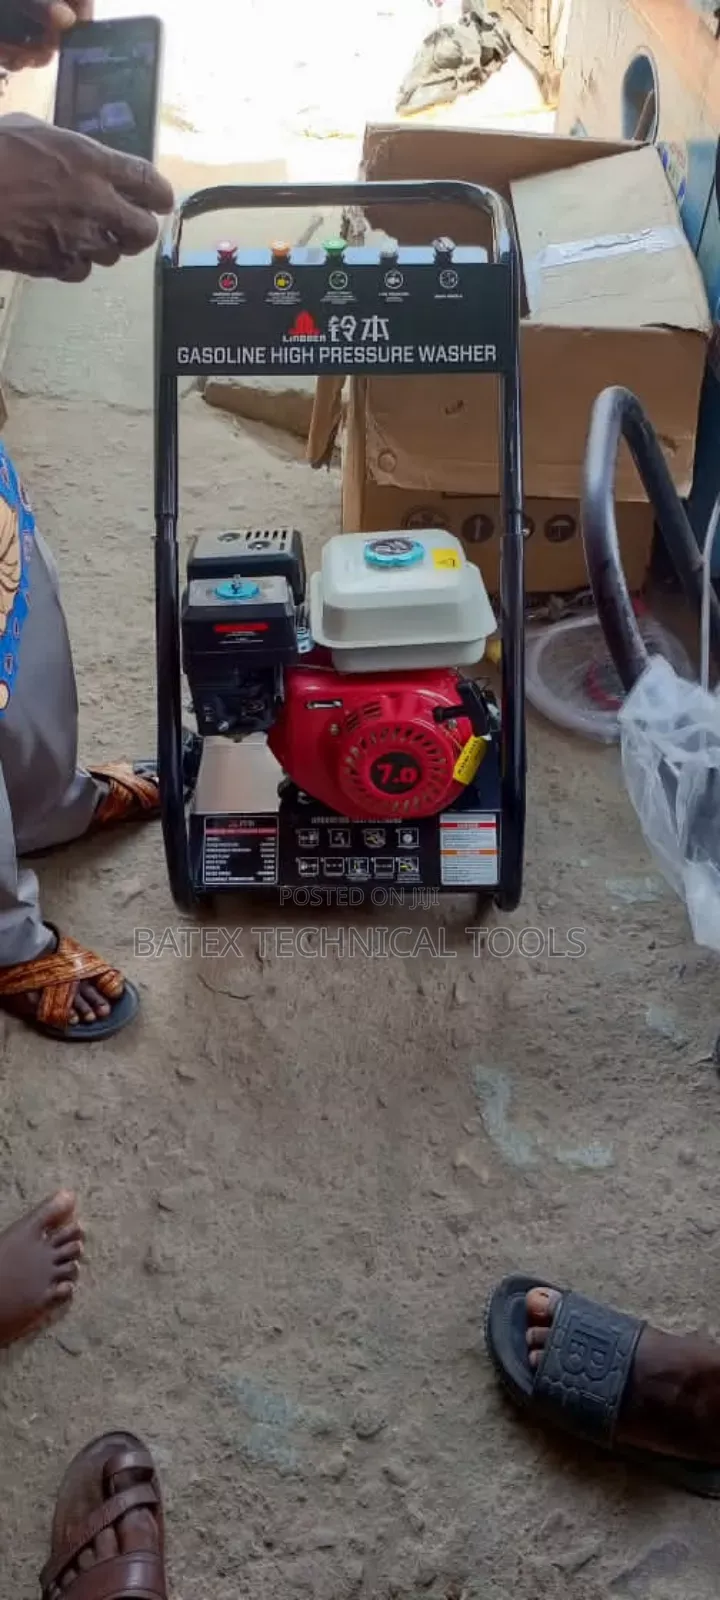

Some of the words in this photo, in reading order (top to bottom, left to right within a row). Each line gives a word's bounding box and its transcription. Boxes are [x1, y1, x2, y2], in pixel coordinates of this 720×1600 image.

[177, 346, 266, 365] GASOLINE
[271, 346, 314, 364] HIGH
[319, 345, 414, 364] PRESSURE
[418, 344, 497, 363] WASHER
[376, 763, 418, 785] 7.0
